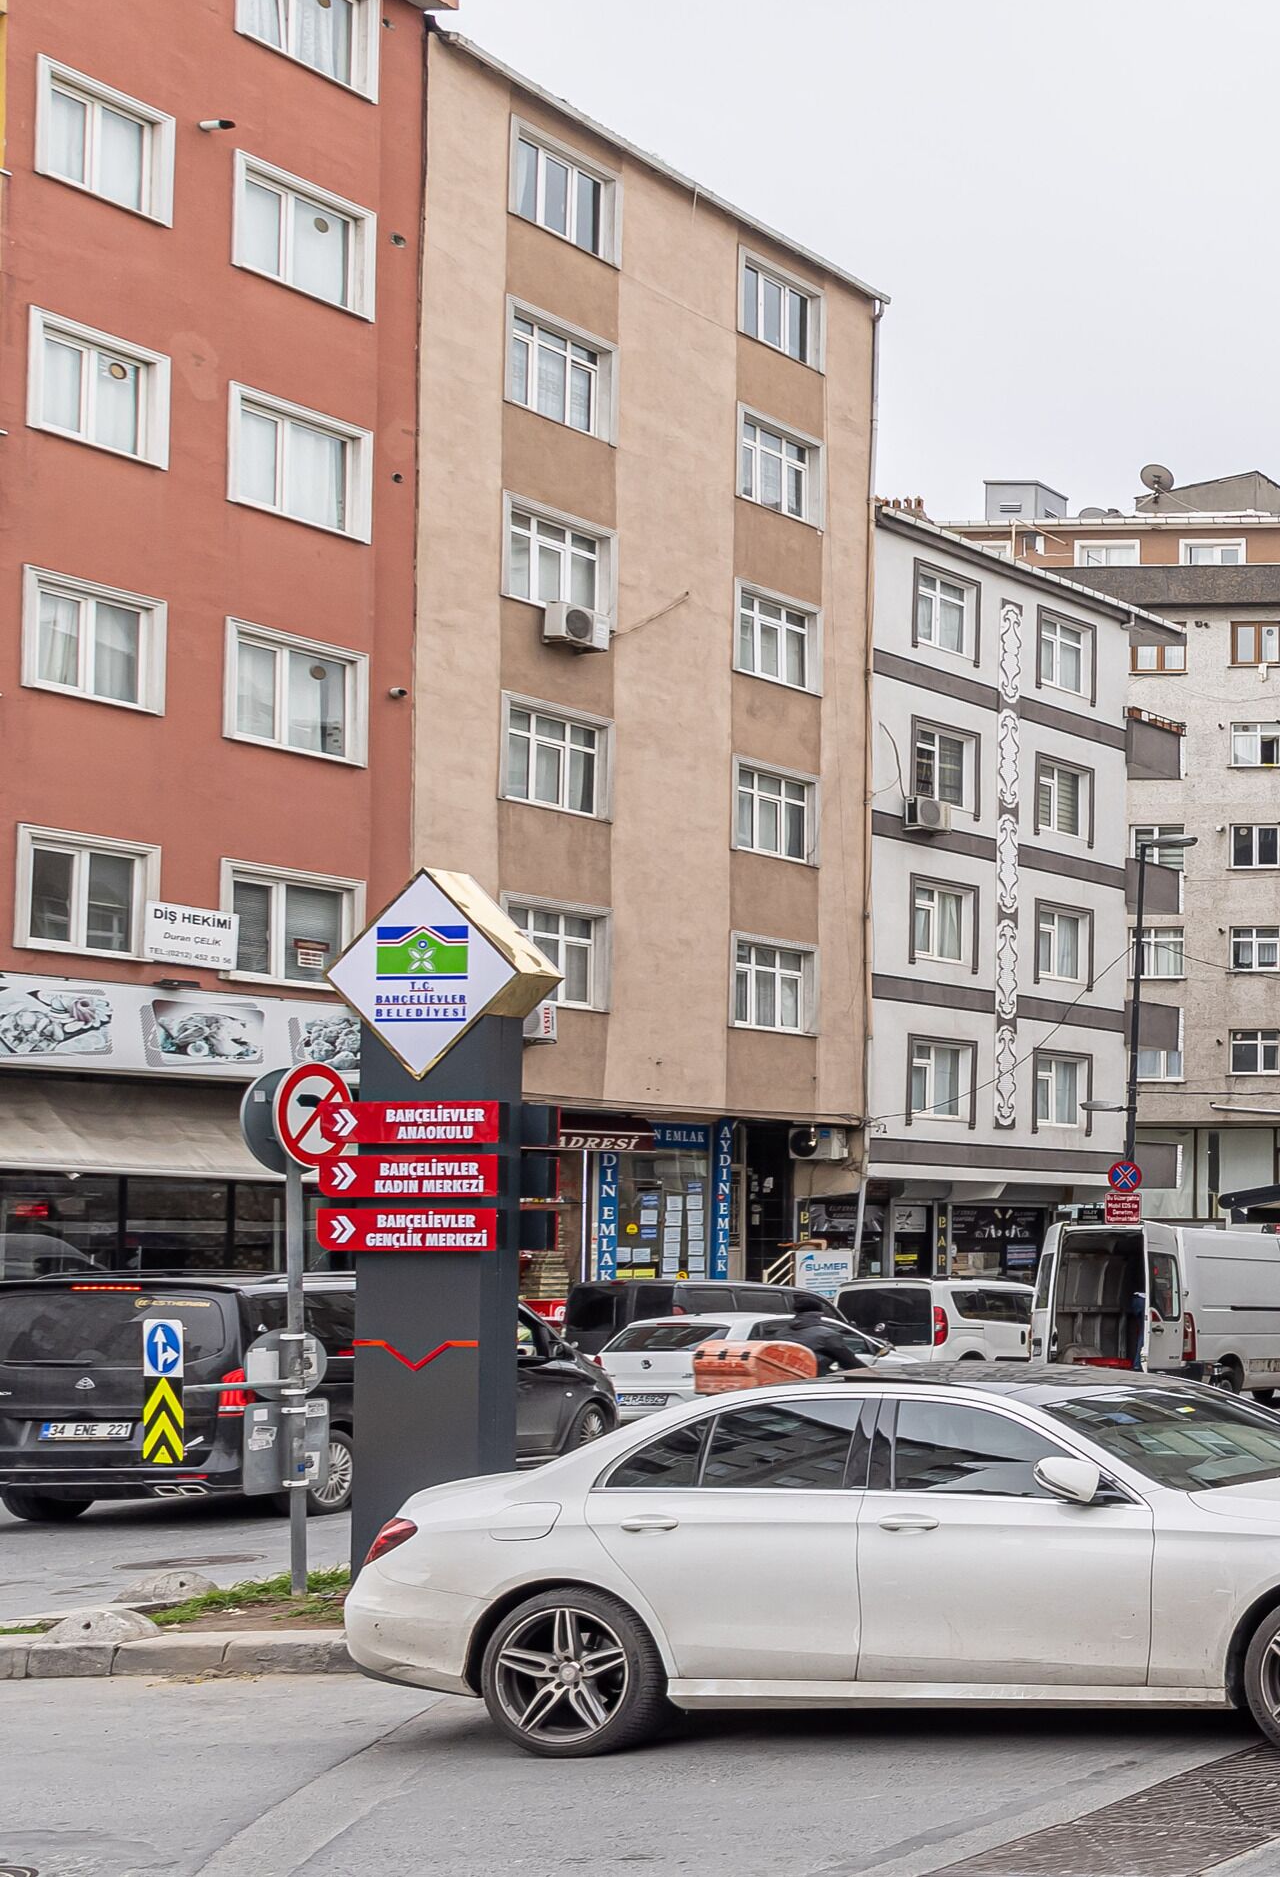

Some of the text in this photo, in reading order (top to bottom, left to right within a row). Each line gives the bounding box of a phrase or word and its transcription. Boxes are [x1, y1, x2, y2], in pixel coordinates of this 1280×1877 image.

[153, 907, 232, 930] DİŞ HEKİMİ
[163, 931, 222, 946] Duran ÇELİK
[375, 992, 466, 1005] BAHÇELİEVLER
[375, 1006, 467, 1017] BELEDİYESİ
[385, 1104, 485, 1125] BAHÇELİEVLER
[397, 1126, 474, 1140] ANAOKULU
[666, 1129, 704, 1143] EMLAK
[379, 1158, 479, 1178] BAHÇELİEVLER
[374, 1175, 485, 1193] KADIN MERKEZİ
[716, 1125, 732, 1272] AYDIN EMLAK
[376, 1211, 476, 1231] BAHÇELİEVLER
[599, 1153, 617, 1281] DIN EMLAK
[366, 1228, 488, 1248] GENÇLİK MERKEZİ
[805, 1262, 848, 1272] SU-MER
[51, 1424, 130, 1436] 34 ENE 221
